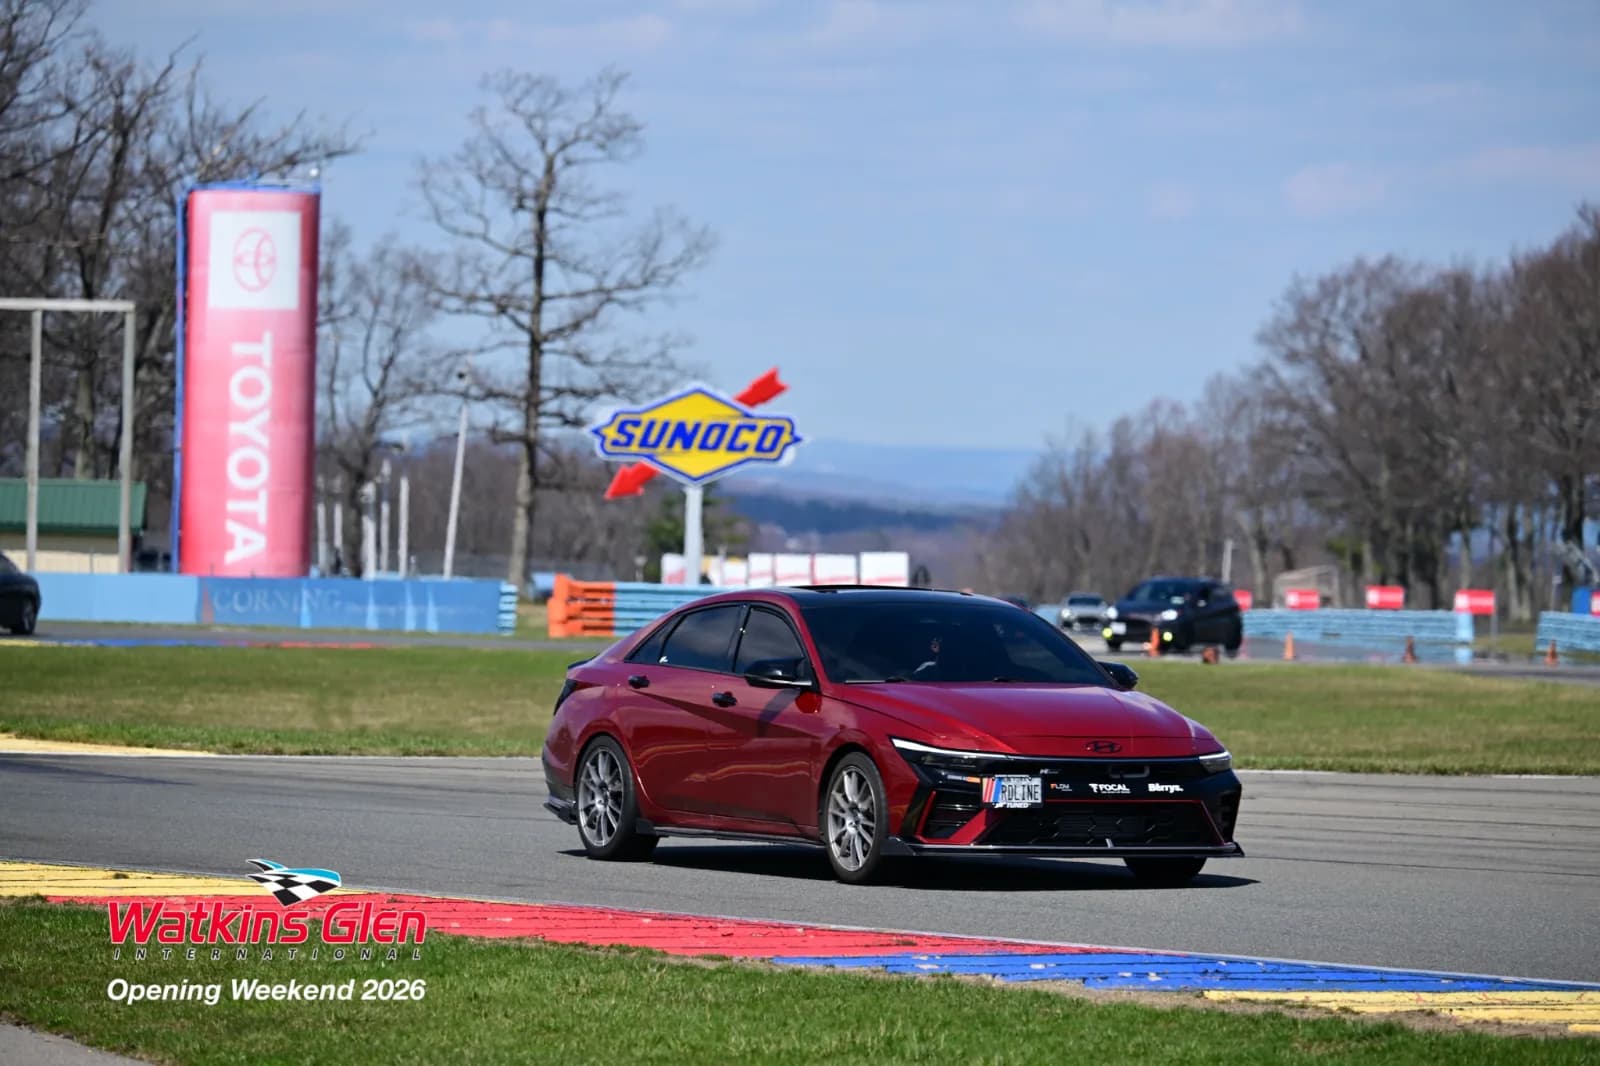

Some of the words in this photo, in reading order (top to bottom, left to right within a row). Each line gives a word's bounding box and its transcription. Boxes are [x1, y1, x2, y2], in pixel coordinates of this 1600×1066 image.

[224, 330, 273, 565] TOYOTA
[610, 419, 786, 453] SUNOCO
[213, 587, 342, 613] CORNING
[1001, 784, 1040, 801] RDLINE
[1098, 783, 1130, 791] FOCAL
